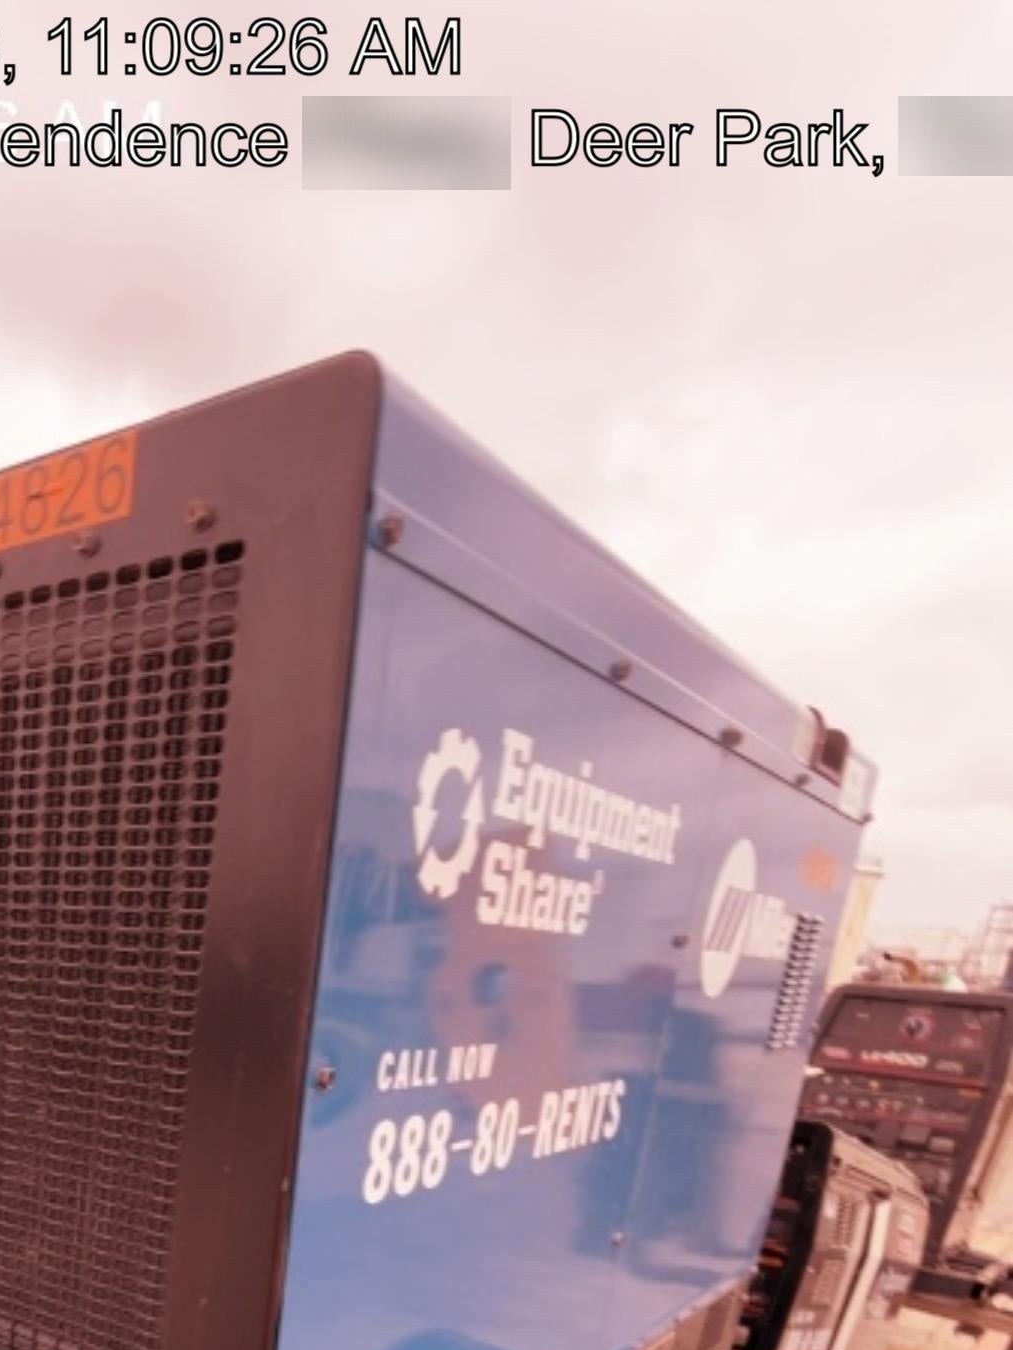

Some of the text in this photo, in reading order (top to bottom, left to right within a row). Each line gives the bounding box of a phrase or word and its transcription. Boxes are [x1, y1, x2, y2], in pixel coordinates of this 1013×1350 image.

[493, 727, 681, 865] Equipment
[377, 1044, 497, 1092] CALL NOW
[363, 1079, 627, 1204] 888-80-RENTS
